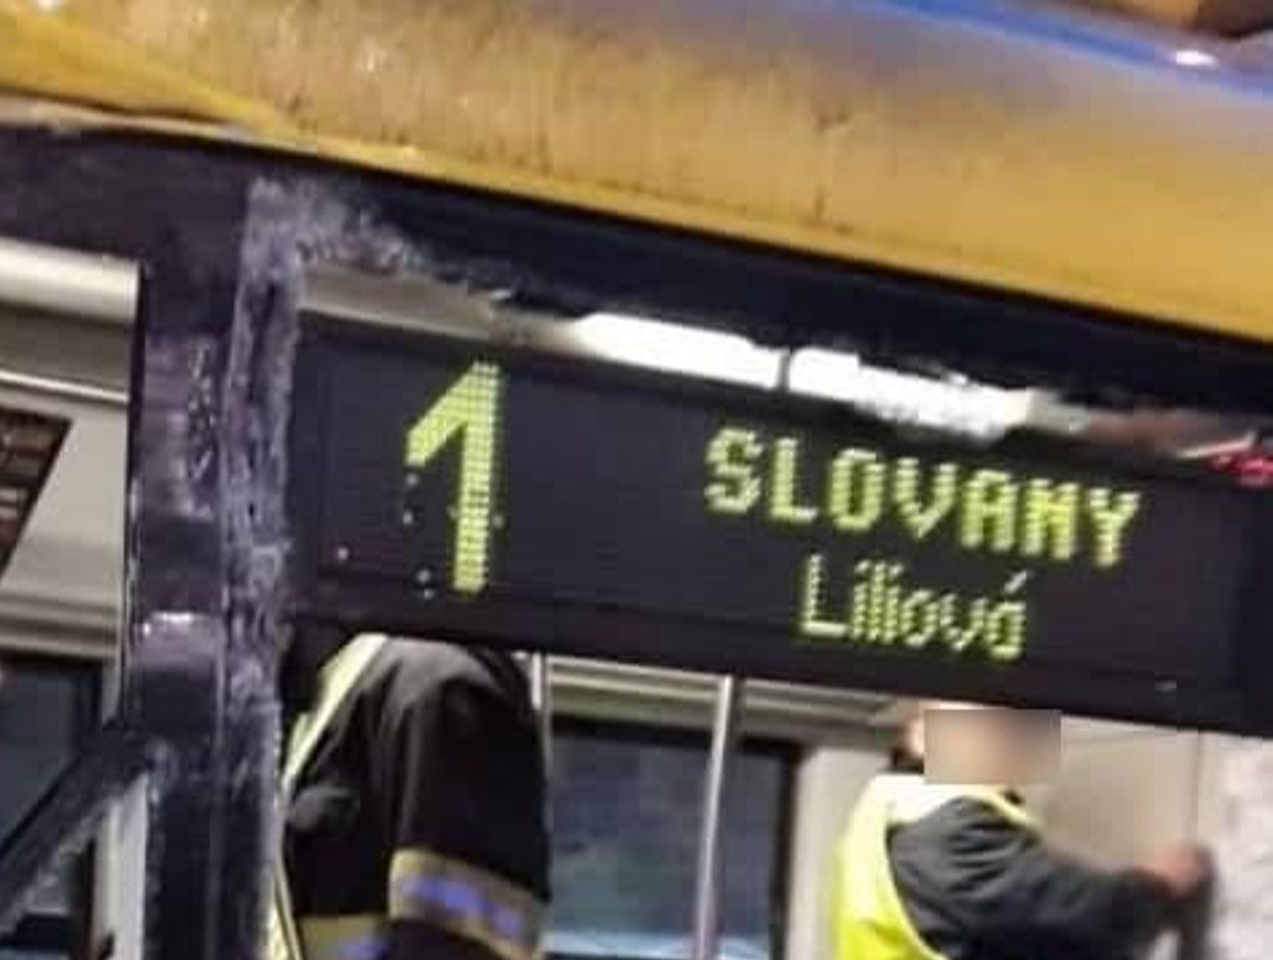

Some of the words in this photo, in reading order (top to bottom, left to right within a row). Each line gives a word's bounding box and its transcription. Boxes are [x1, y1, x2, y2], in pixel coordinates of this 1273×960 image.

[405, 361, 500, 593] 1
[703, 427, 1143, 567] SLOVANY
[800, 553, 1032, 660] Liliová
